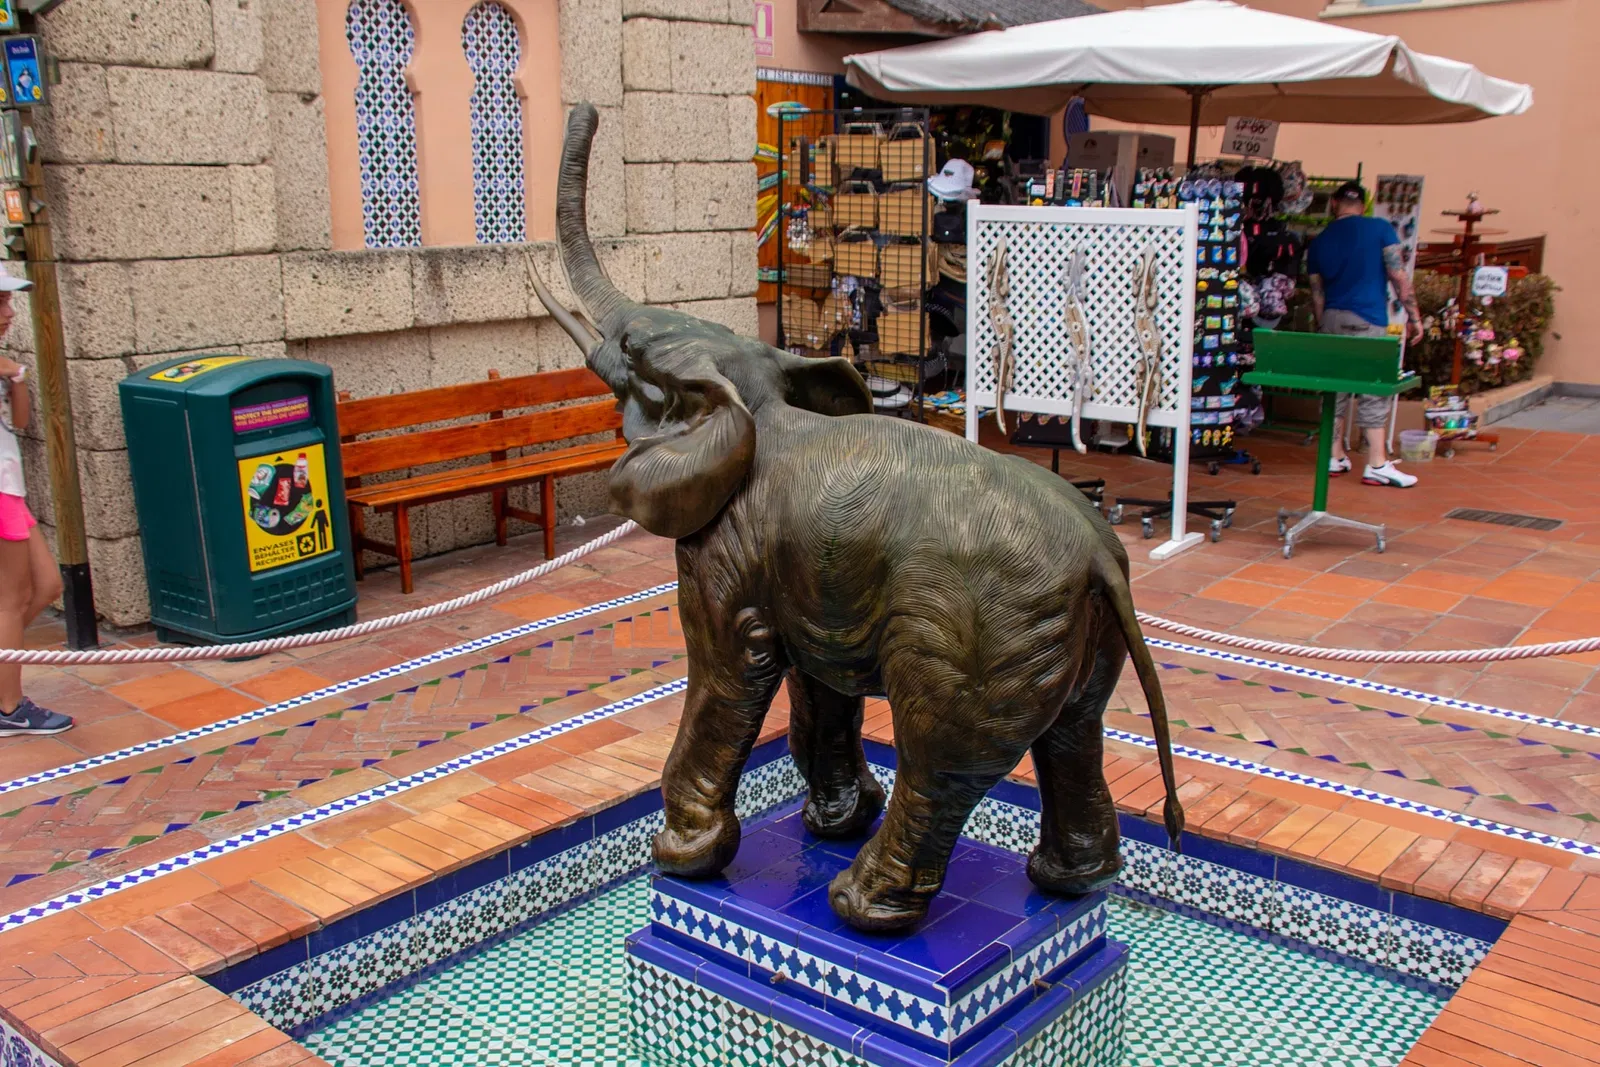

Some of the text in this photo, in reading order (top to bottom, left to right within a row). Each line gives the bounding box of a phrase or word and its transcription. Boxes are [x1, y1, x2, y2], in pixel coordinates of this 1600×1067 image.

[233, 411, 261, 421] PROTECT
[272, 402, 308, 415] ENVIRONMENT
[253, 540, 294, 554] ENVASES
[255, 552, 296, 567] RECIPIENT
